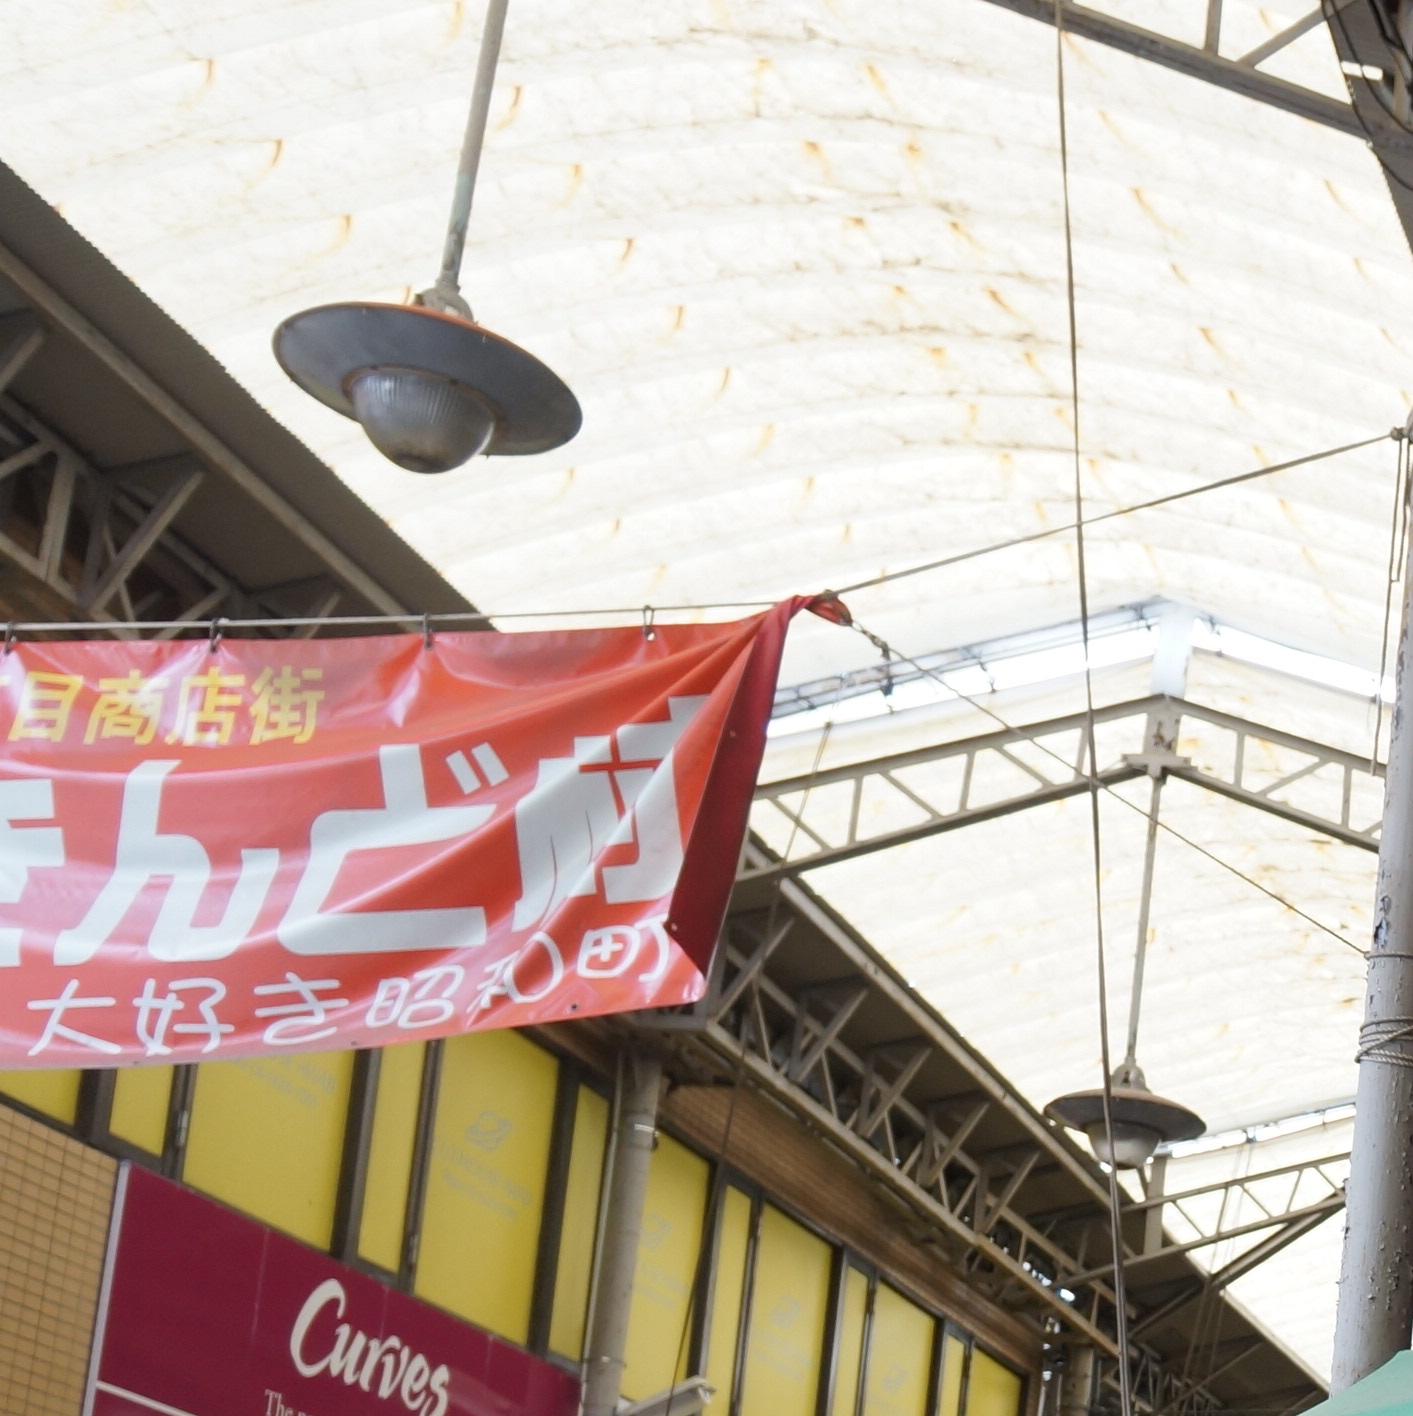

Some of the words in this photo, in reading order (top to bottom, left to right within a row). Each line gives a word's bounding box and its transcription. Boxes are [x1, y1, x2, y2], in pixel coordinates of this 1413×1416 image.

[0, 666, 325, 746] 目商店街
[28, 919, 673, 1058] 大好き昭和町
